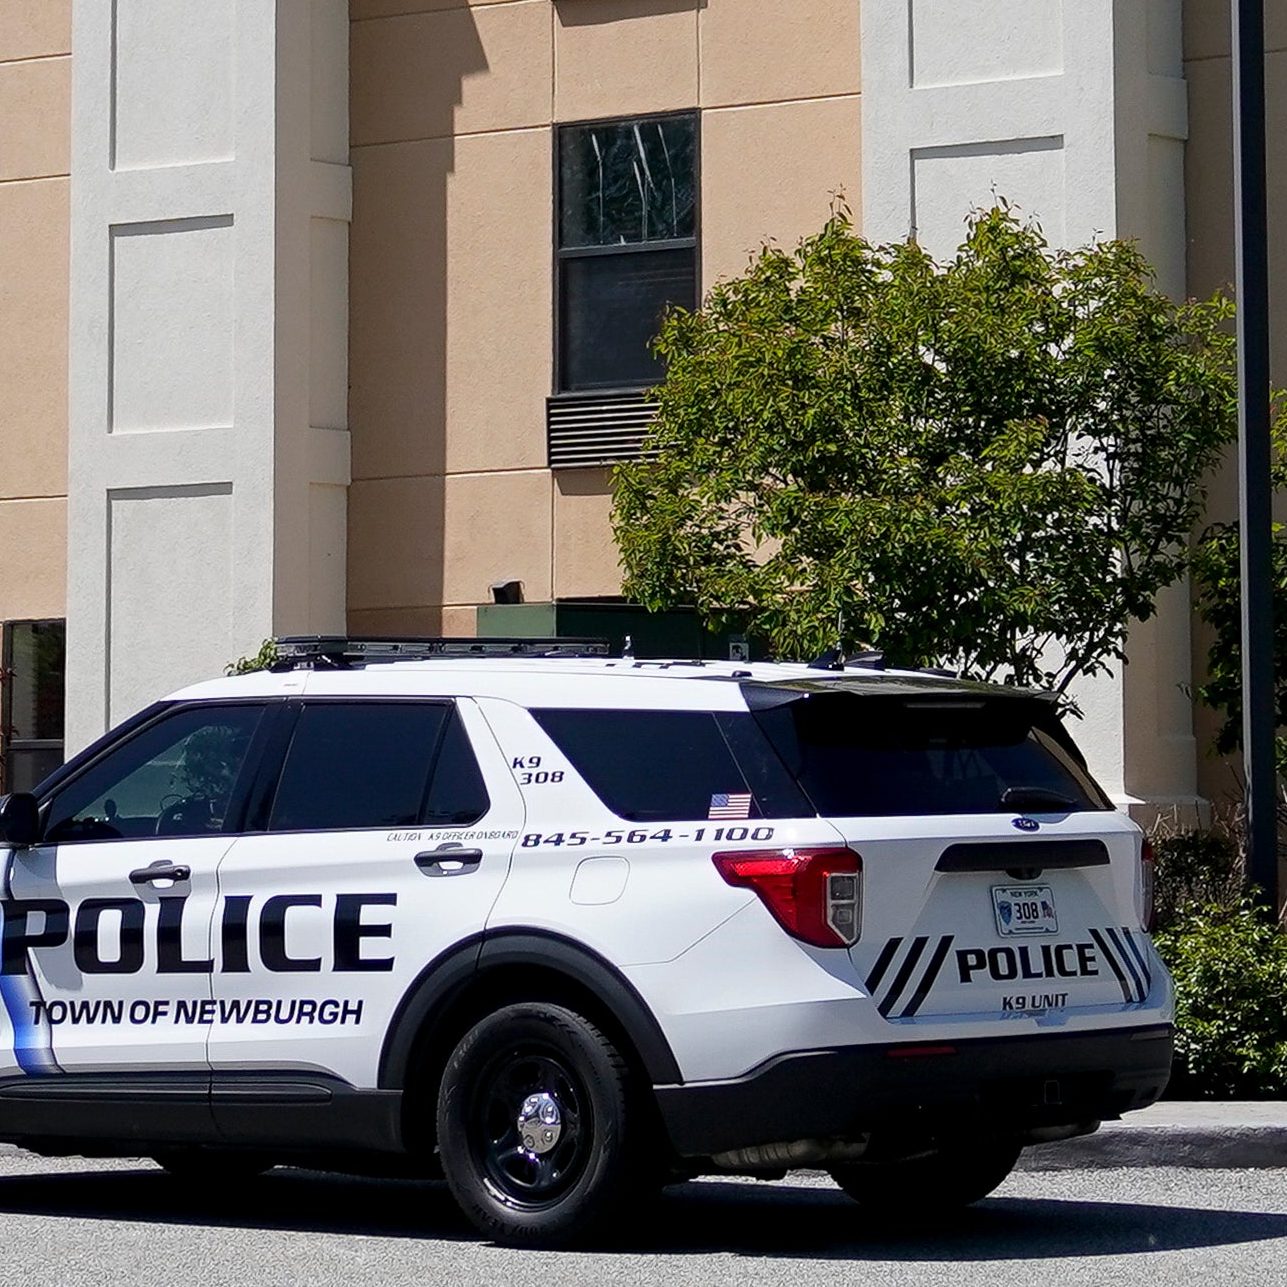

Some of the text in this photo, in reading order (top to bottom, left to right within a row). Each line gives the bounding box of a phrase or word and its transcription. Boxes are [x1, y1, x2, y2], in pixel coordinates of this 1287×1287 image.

[512, 756, 542, 769] K9
[520, 771, 565, 786] 308
[521, 827, 775, 848] 845-564-1100
[1014, 901, 1040, 921] 308
[0, 893, 398, 975] POLICE
[955, 943, 1100, 984] POLICE
[1002, 993, 1069, 1011] K9 UNIT
[29, 999, 364, 1026] TOWN OF NEWBURGH
